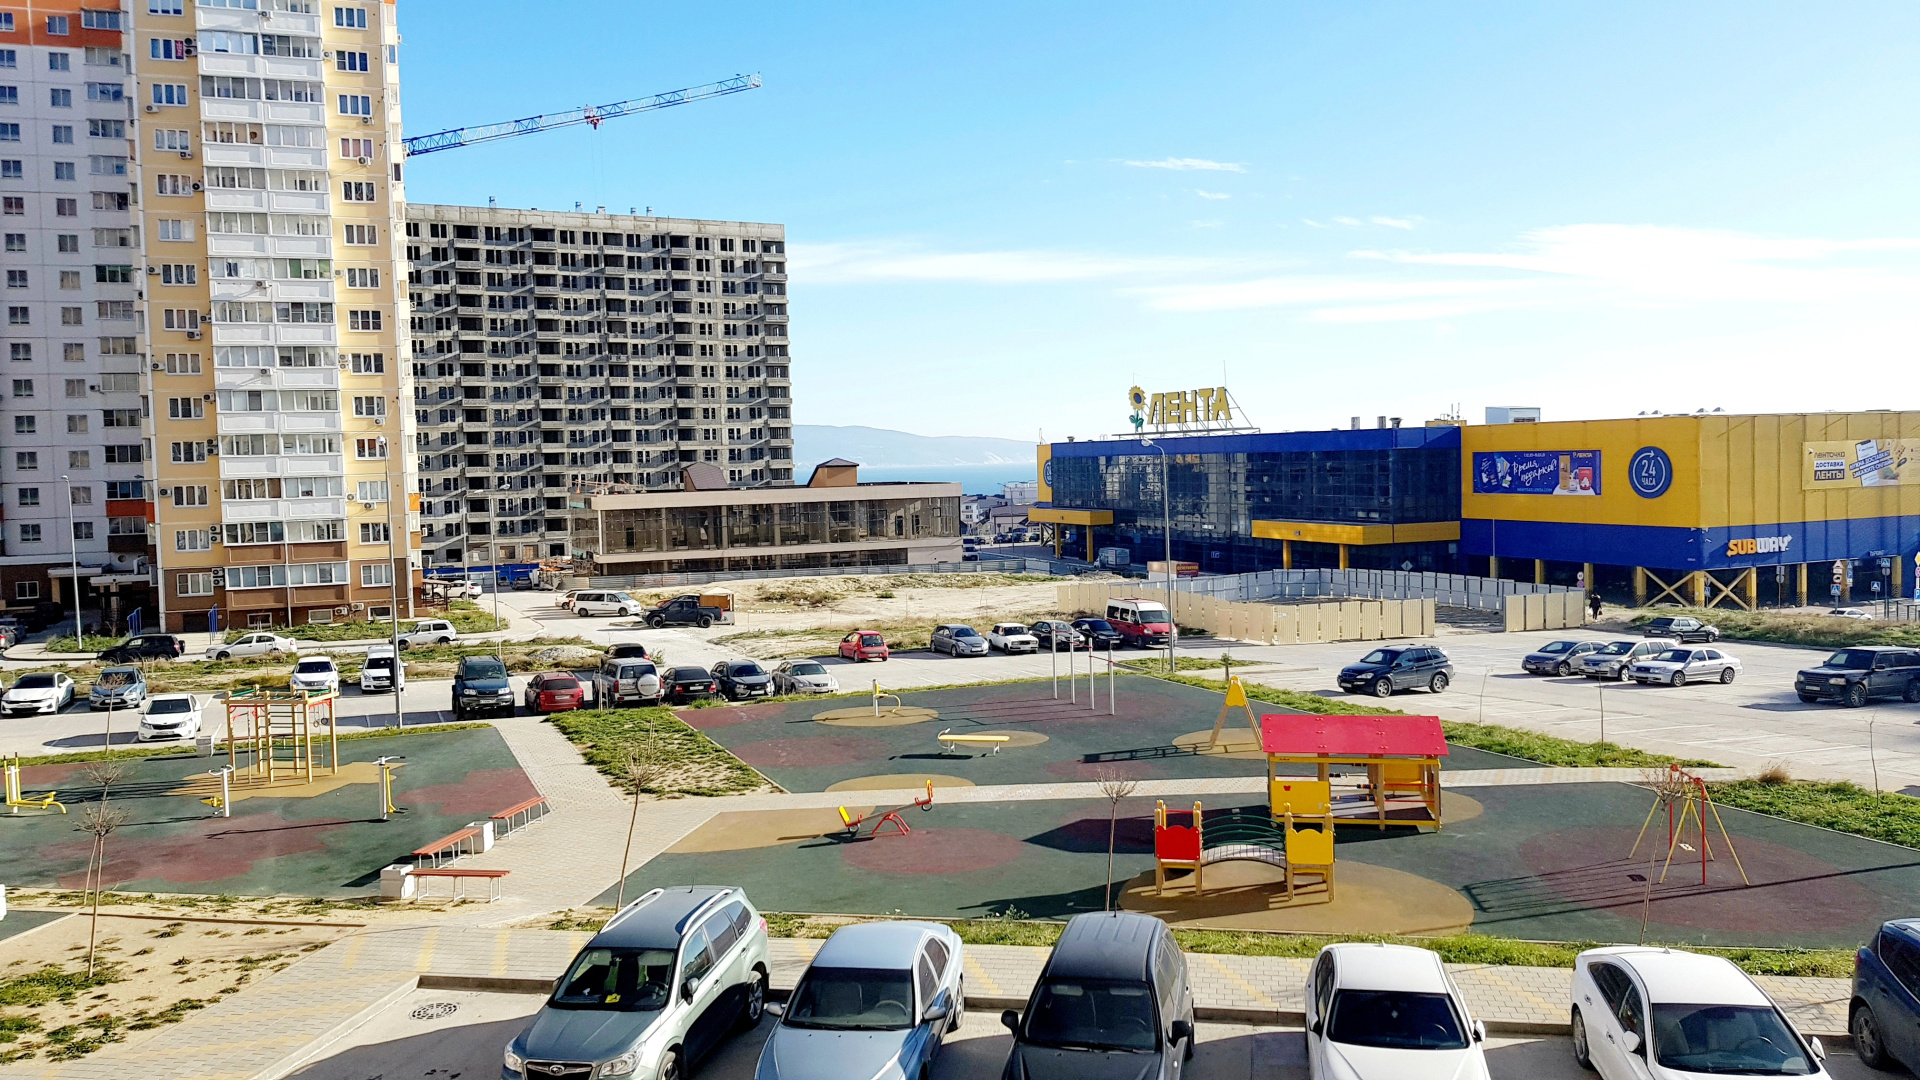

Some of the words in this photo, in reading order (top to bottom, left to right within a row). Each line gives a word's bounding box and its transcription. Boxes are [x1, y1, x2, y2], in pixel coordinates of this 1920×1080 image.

[1147, 387, 1232, 424] ЛЕНТА
[1641, 459, 1656, 477] 24
[1815, 470, 1844, 480] ЛЕНТЫ
[1641, 477, 1656, 486] ЧАСА
[1726, 534, 1793, 557] SUBWAY
